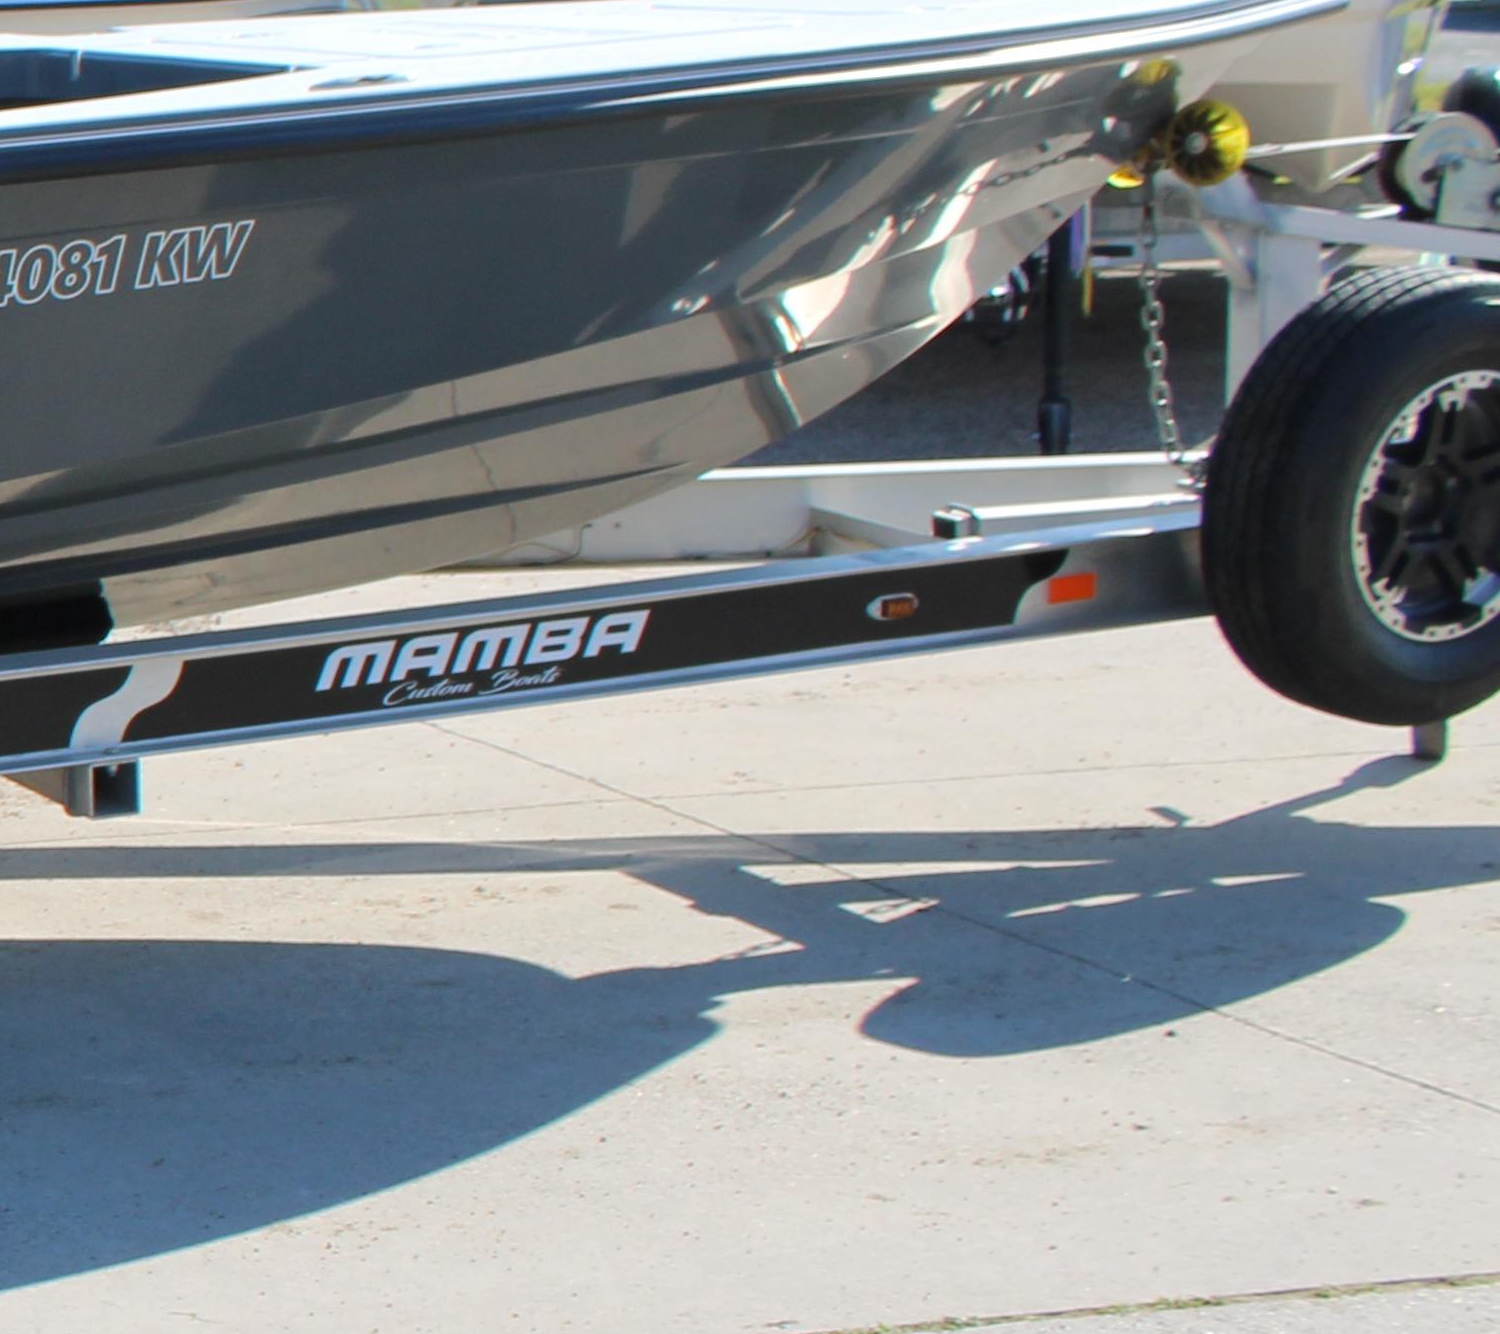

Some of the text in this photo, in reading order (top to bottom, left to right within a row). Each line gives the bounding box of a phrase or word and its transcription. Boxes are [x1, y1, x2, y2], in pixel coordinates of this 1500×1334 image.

[134, 219, 256, 289] KW
[314, 609, 651, 692] MAMBA
[382, 666, 565, 707] Custom Boats
